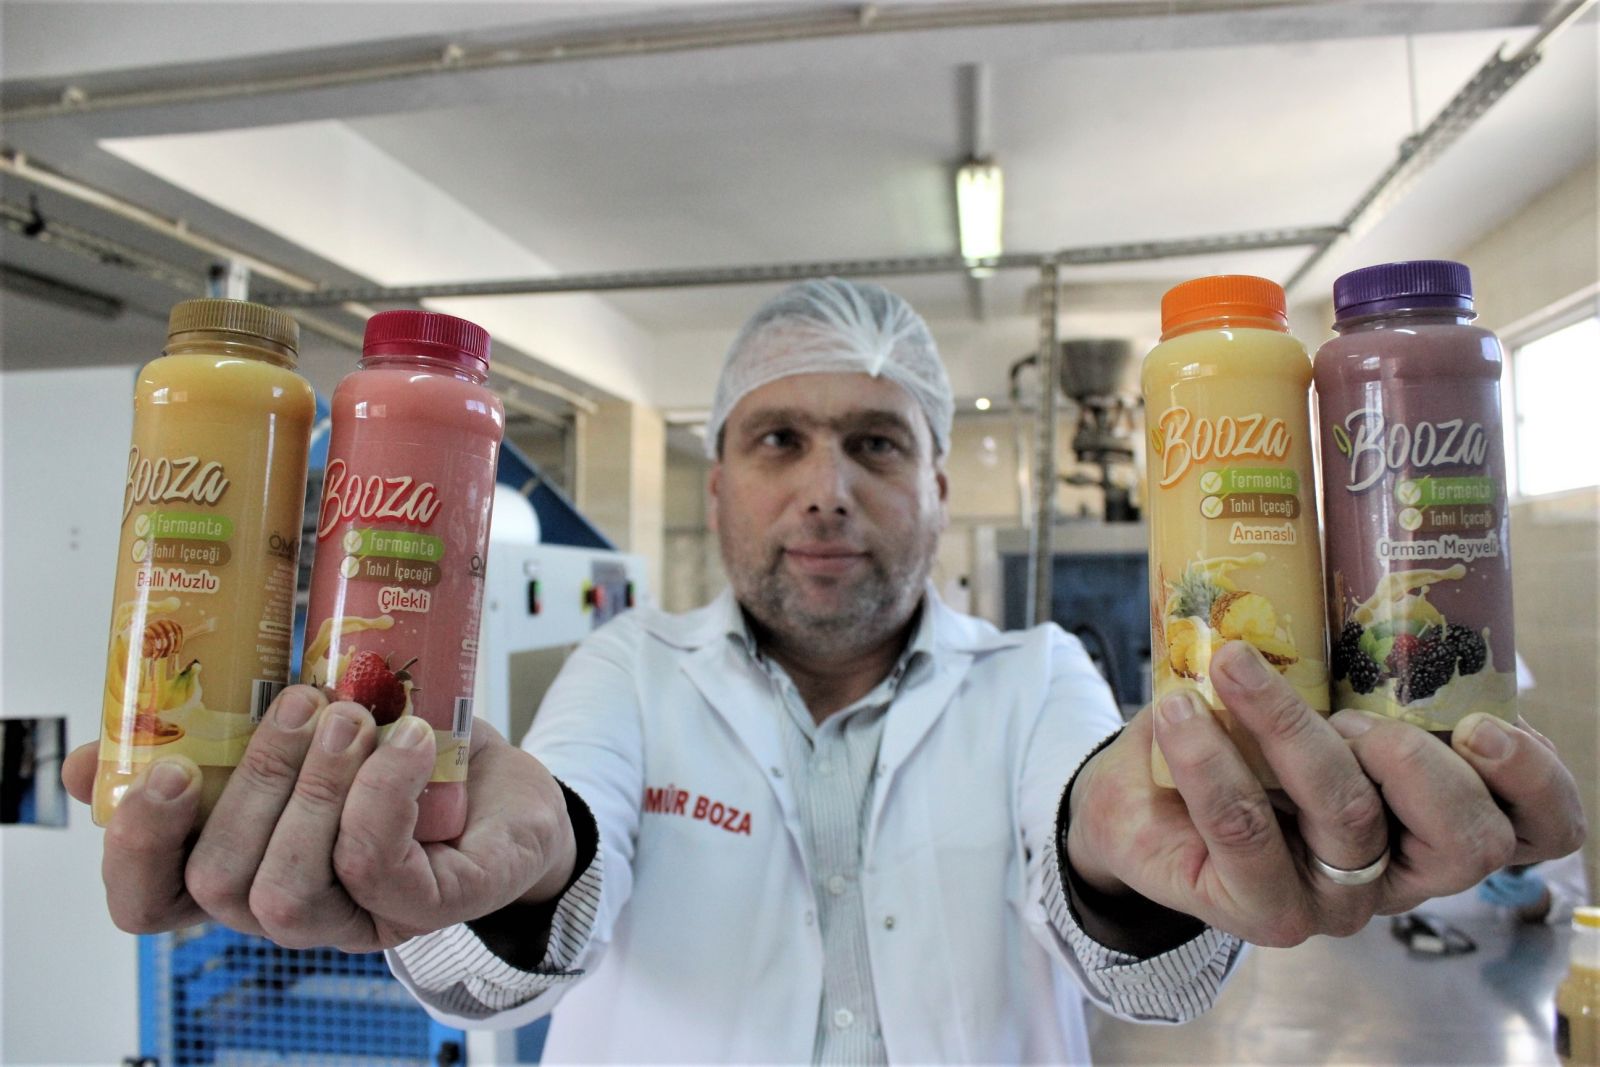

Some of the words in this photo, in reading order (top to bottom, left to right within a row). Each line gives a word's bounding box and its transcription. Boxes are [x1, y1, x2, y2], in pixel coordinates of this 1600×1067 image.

[1231, 470, 1292, 489] Fermente
[1430, 480, 1491, 499] Fermente
[1229, 498, 1255, 513] Tahıl
[157, 513, 223, 536] Fermente
[1233, 525, 1295, 542] Ananaslı
[370, 532, 434, 556] Fermente
[1379, 541, 1438, 556] Orman
[1443, 536, 1497, 558] Meyveli
[137, 571, 164, 588] Ballı
[169, 572, 216, 590] Muzlu
[366, 560, 390, 577] Tahıl
[394, 559, 433, 584] İçeceği
[381, 589, 428, 610] Çilekli
[692, 795, 751, 836] BOZA
